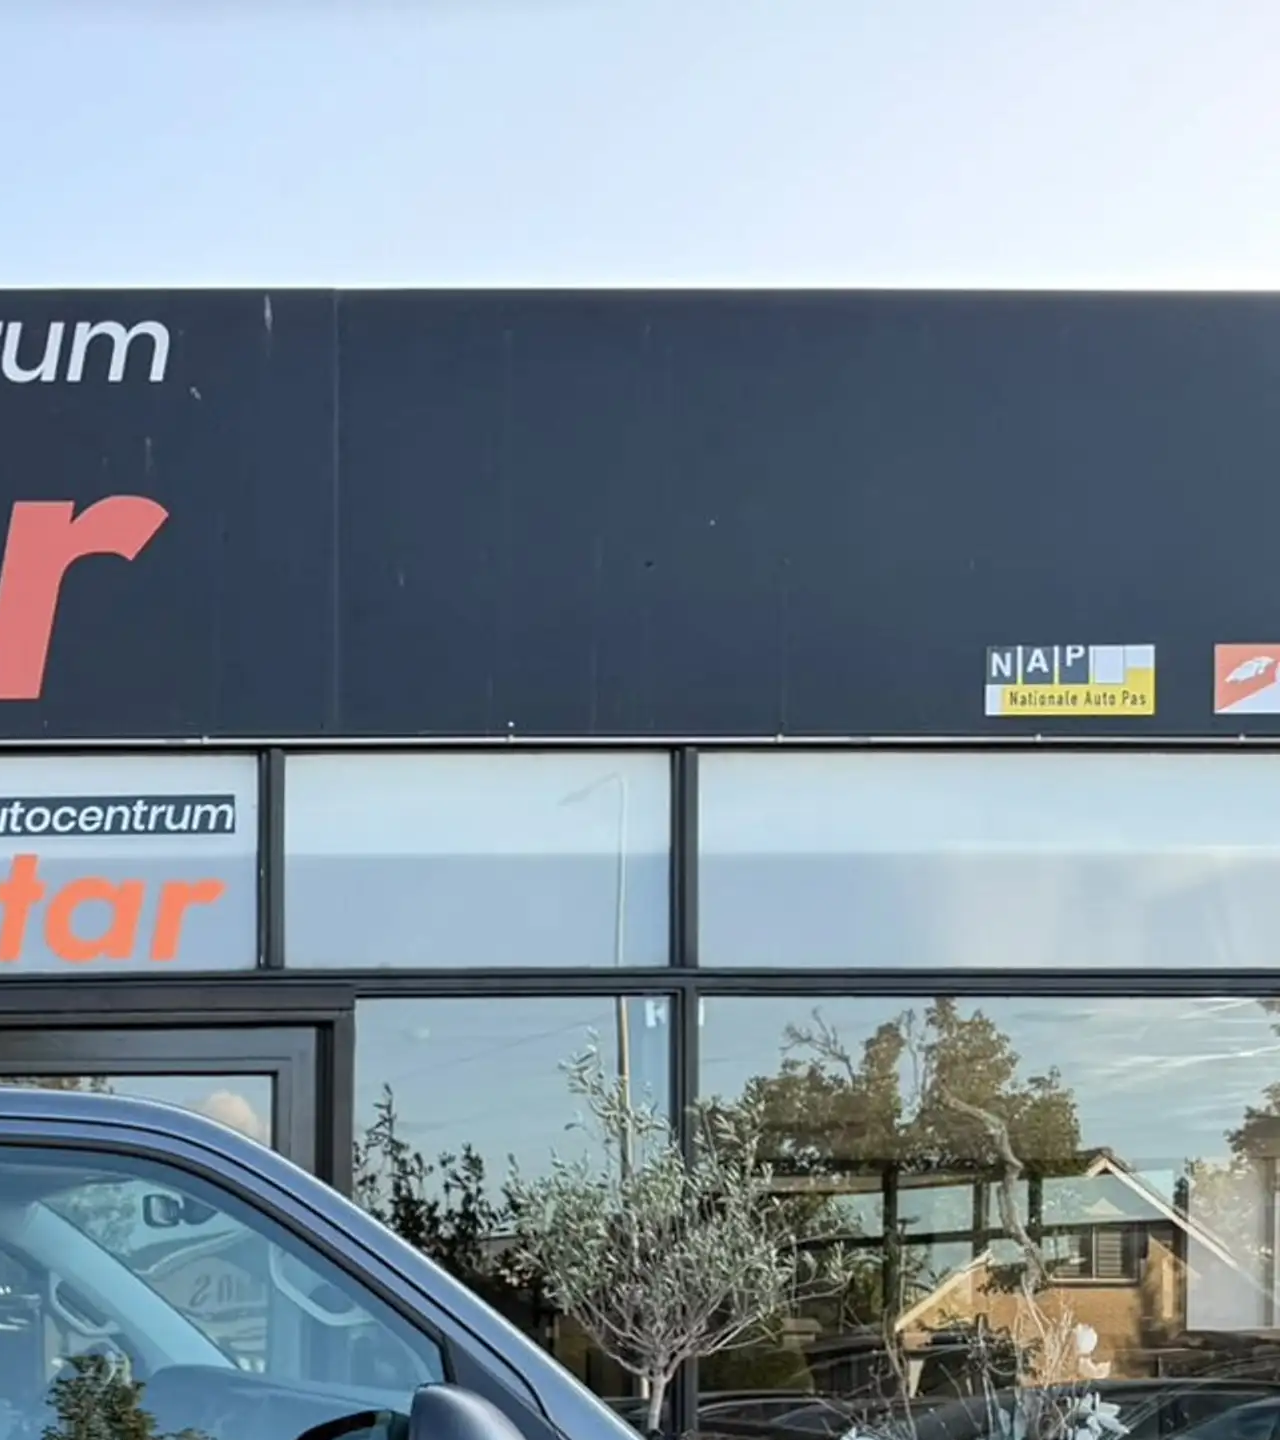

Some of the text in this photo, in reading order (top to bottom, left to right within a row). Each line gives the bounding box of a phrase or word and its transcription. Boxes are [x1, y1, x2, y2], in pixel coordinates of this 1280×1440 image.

[1009, 690, 1146, 706] Nationale Auto Pas
